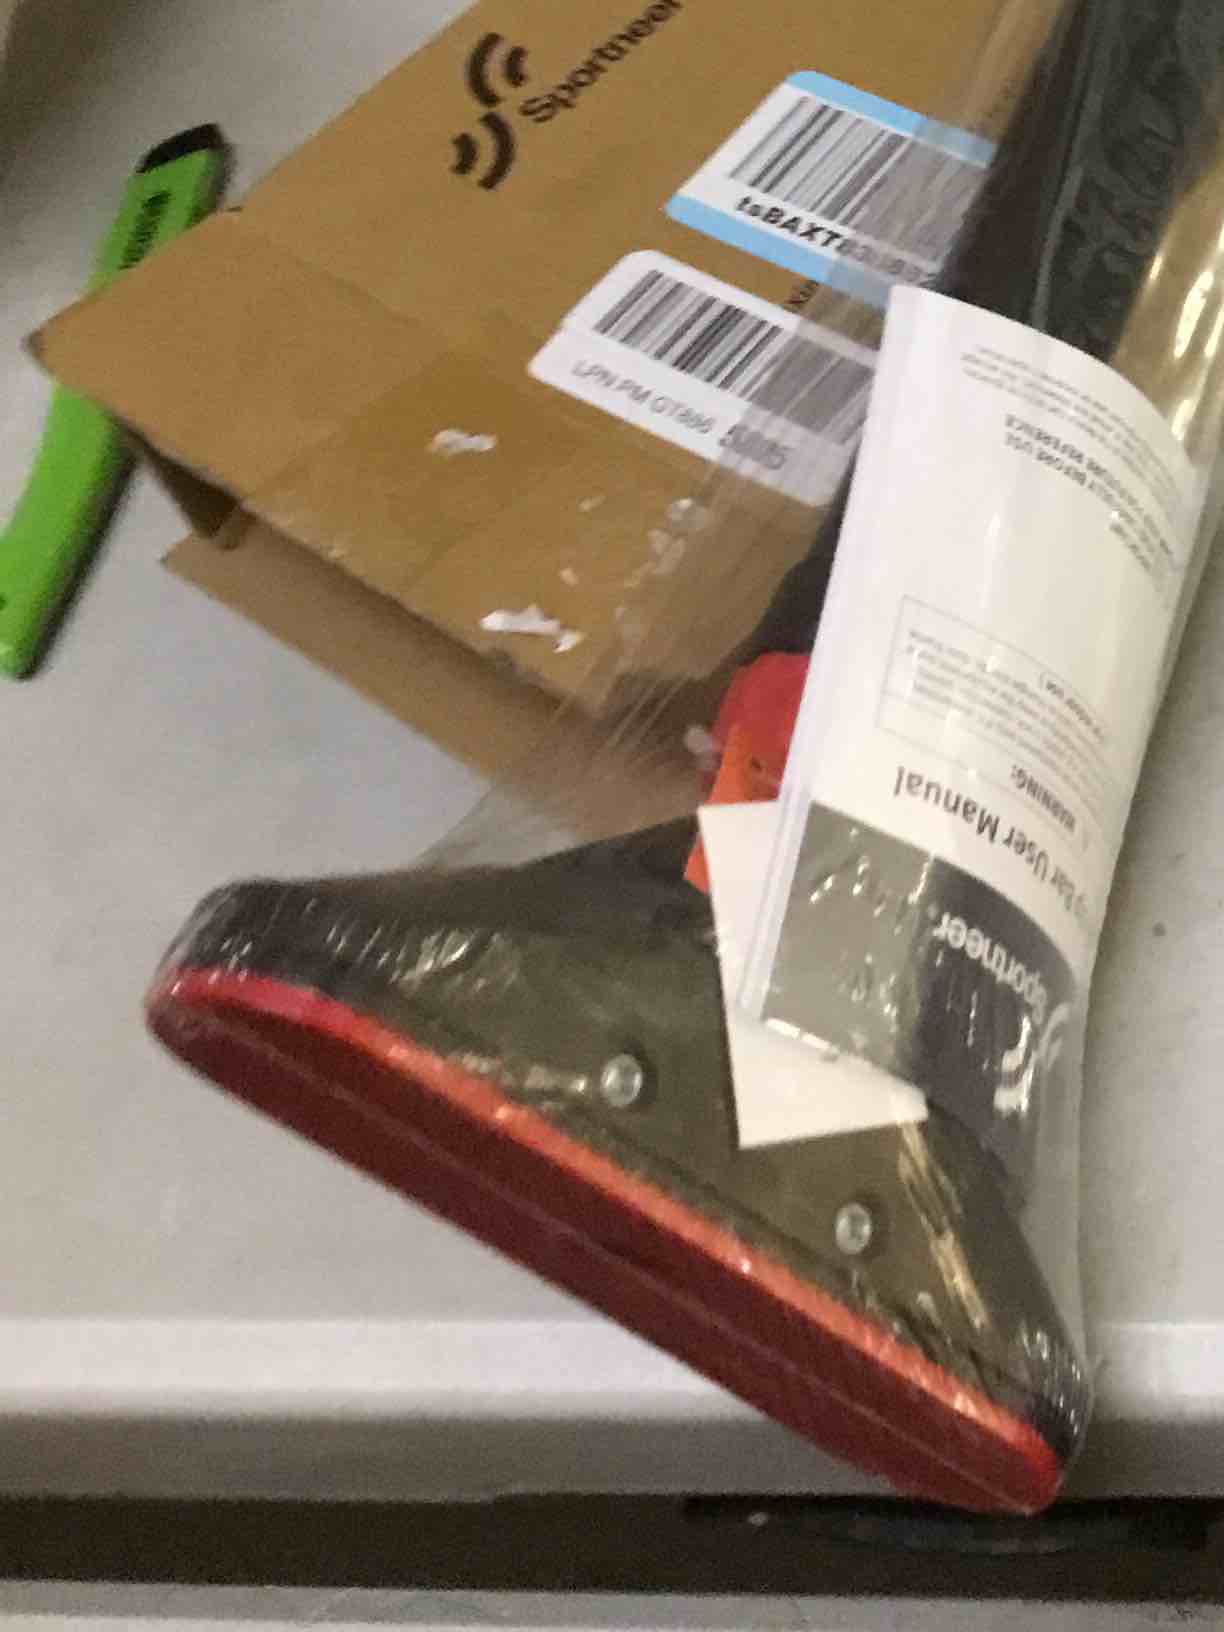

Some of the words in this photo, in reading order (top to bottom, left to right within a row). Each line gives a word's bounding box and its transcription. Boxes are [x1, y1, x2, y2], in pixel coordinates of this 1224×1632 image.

[893, 765, 1000, 844] Manual
[1002, 825, 1049, 881] User
[932, 911, 1048, 1026] Sportneer
